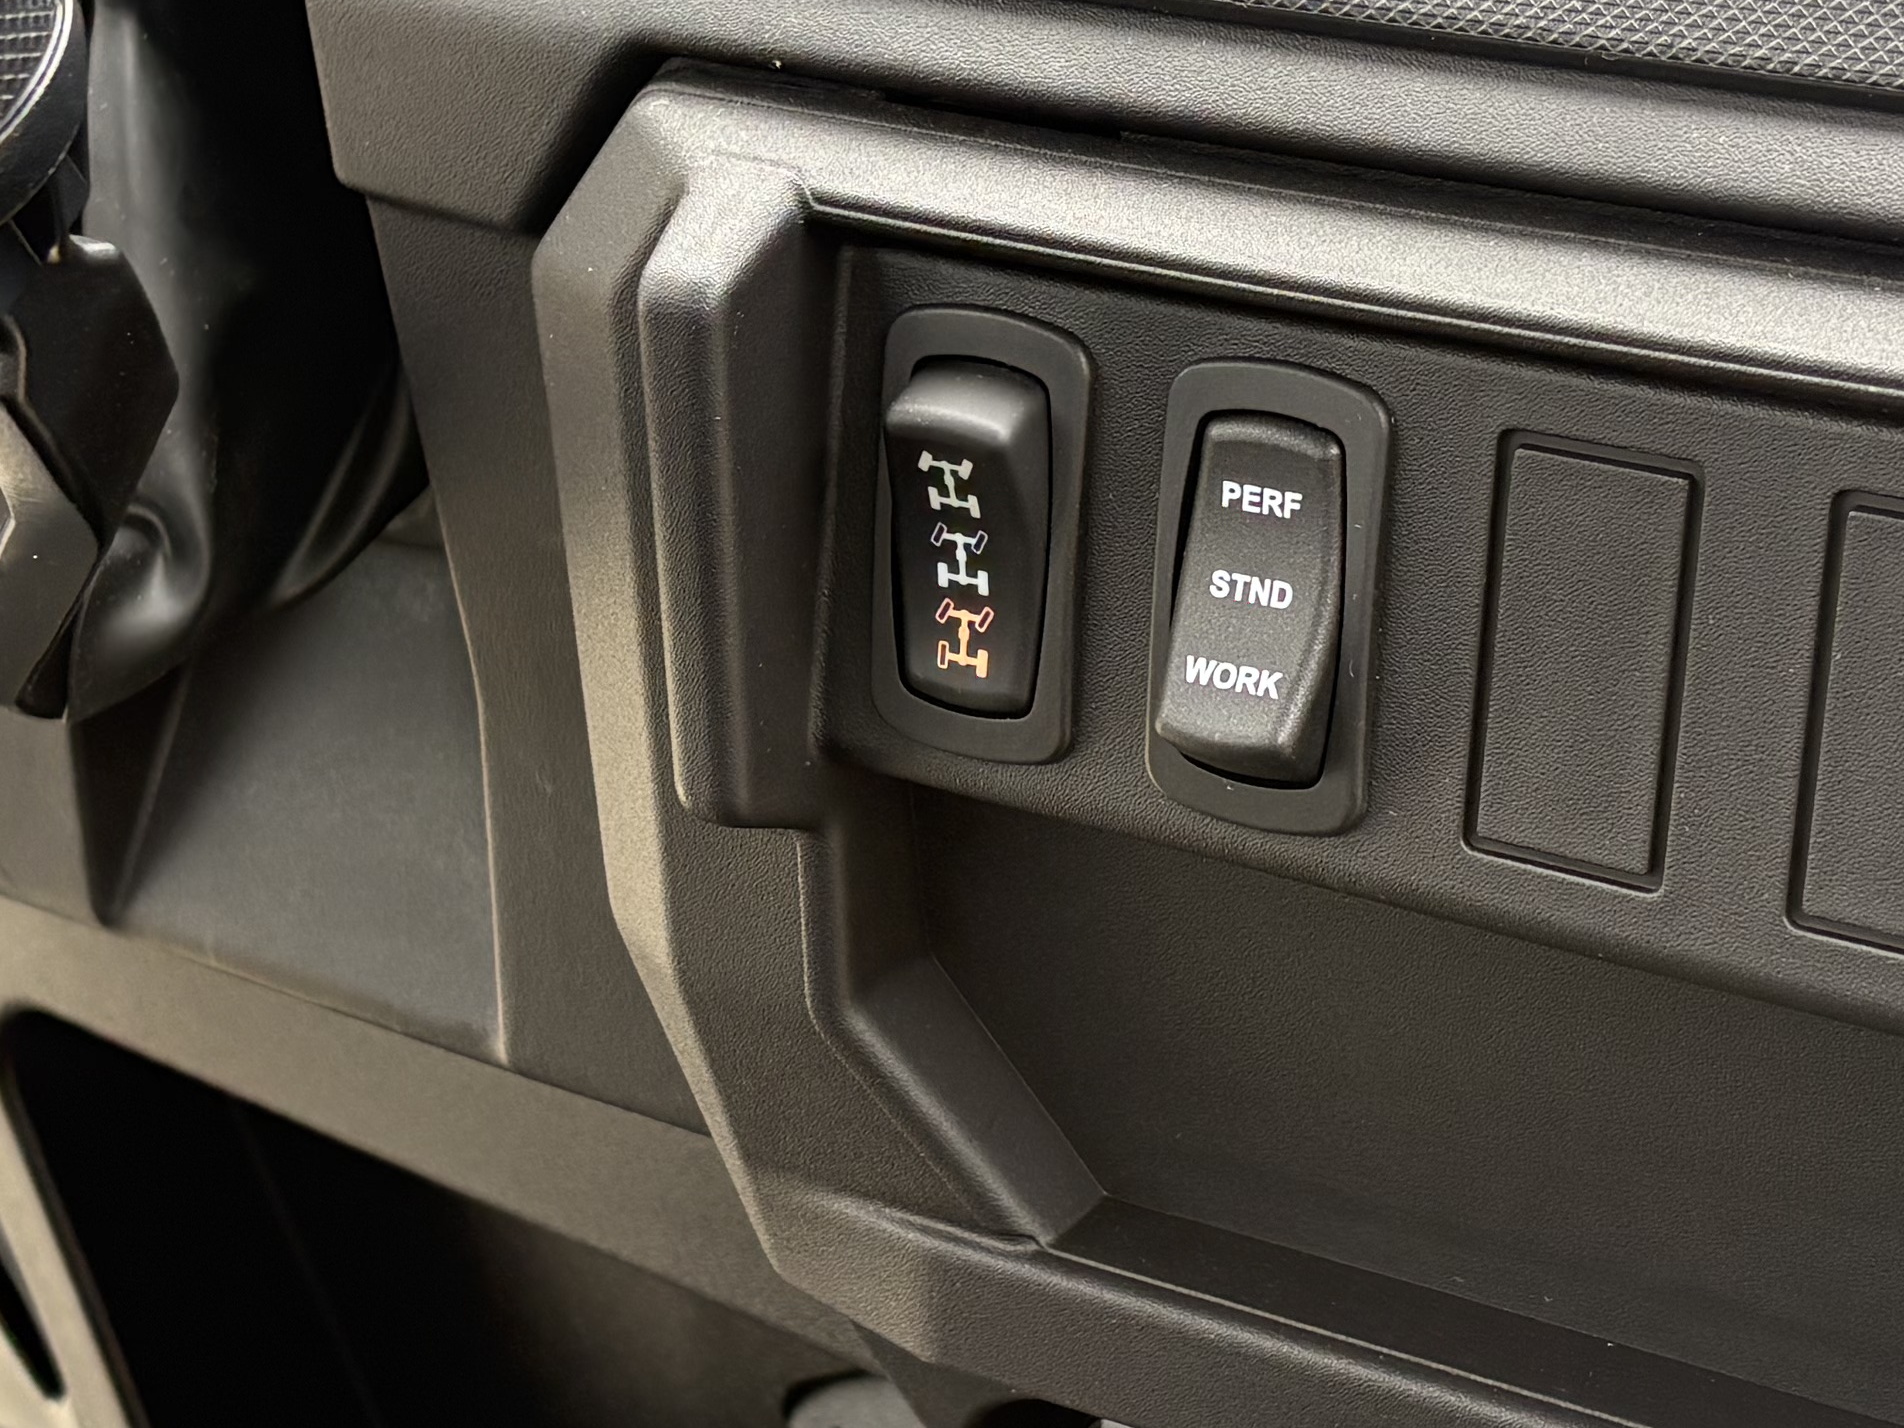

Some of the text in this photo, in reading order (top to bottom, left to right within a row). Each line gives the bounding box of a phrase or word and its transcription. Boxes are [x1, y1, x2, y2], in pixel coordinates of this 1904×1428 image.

[1221, 480, 1302, 520] PERF
[1209, 569, 1293, 610] STND
[1185, 655, 1284, 699] WORK
